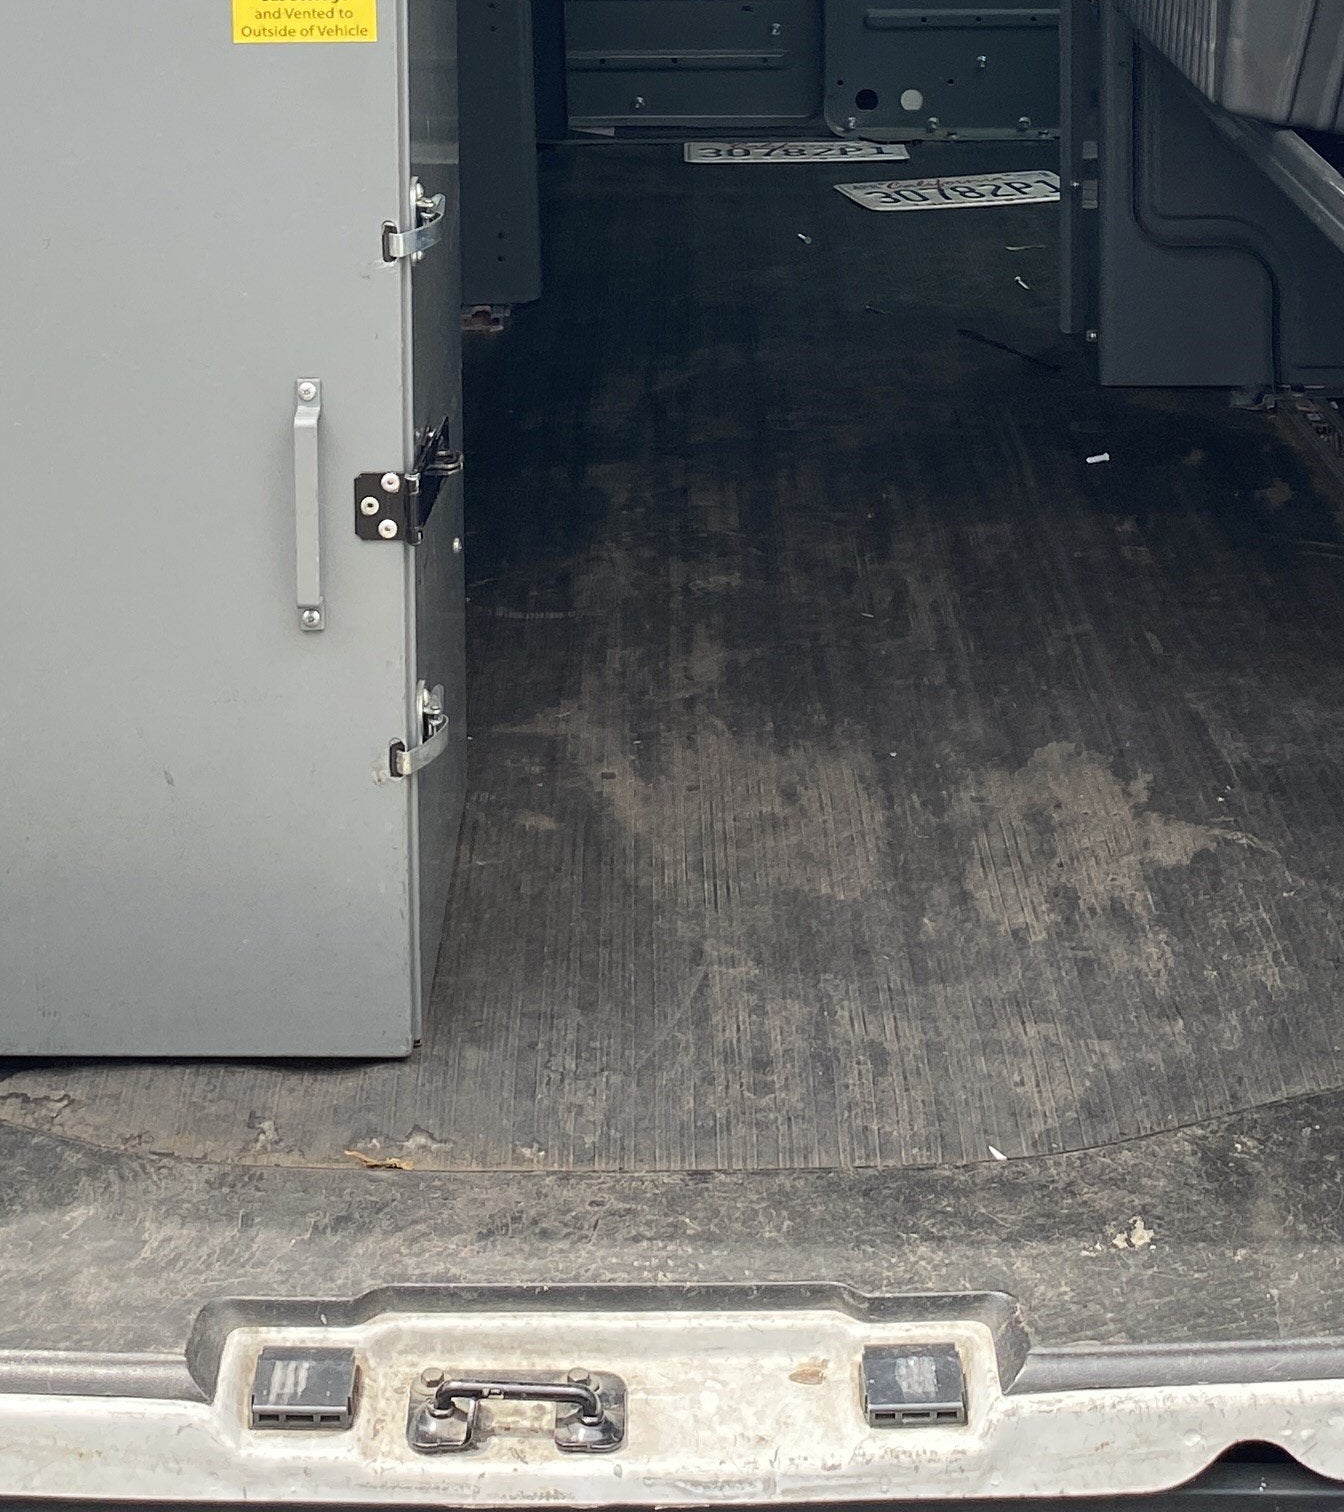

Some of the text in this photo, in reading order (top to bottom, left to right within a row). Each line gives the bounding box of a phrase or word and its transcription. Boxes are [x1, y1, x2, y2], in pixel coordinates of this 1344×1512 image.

[255, 7, 353, 20] and Vented to
[241, 24, 368, 37] Outside of Vehicle
[864, 180, 1060, 203] 30782P1
